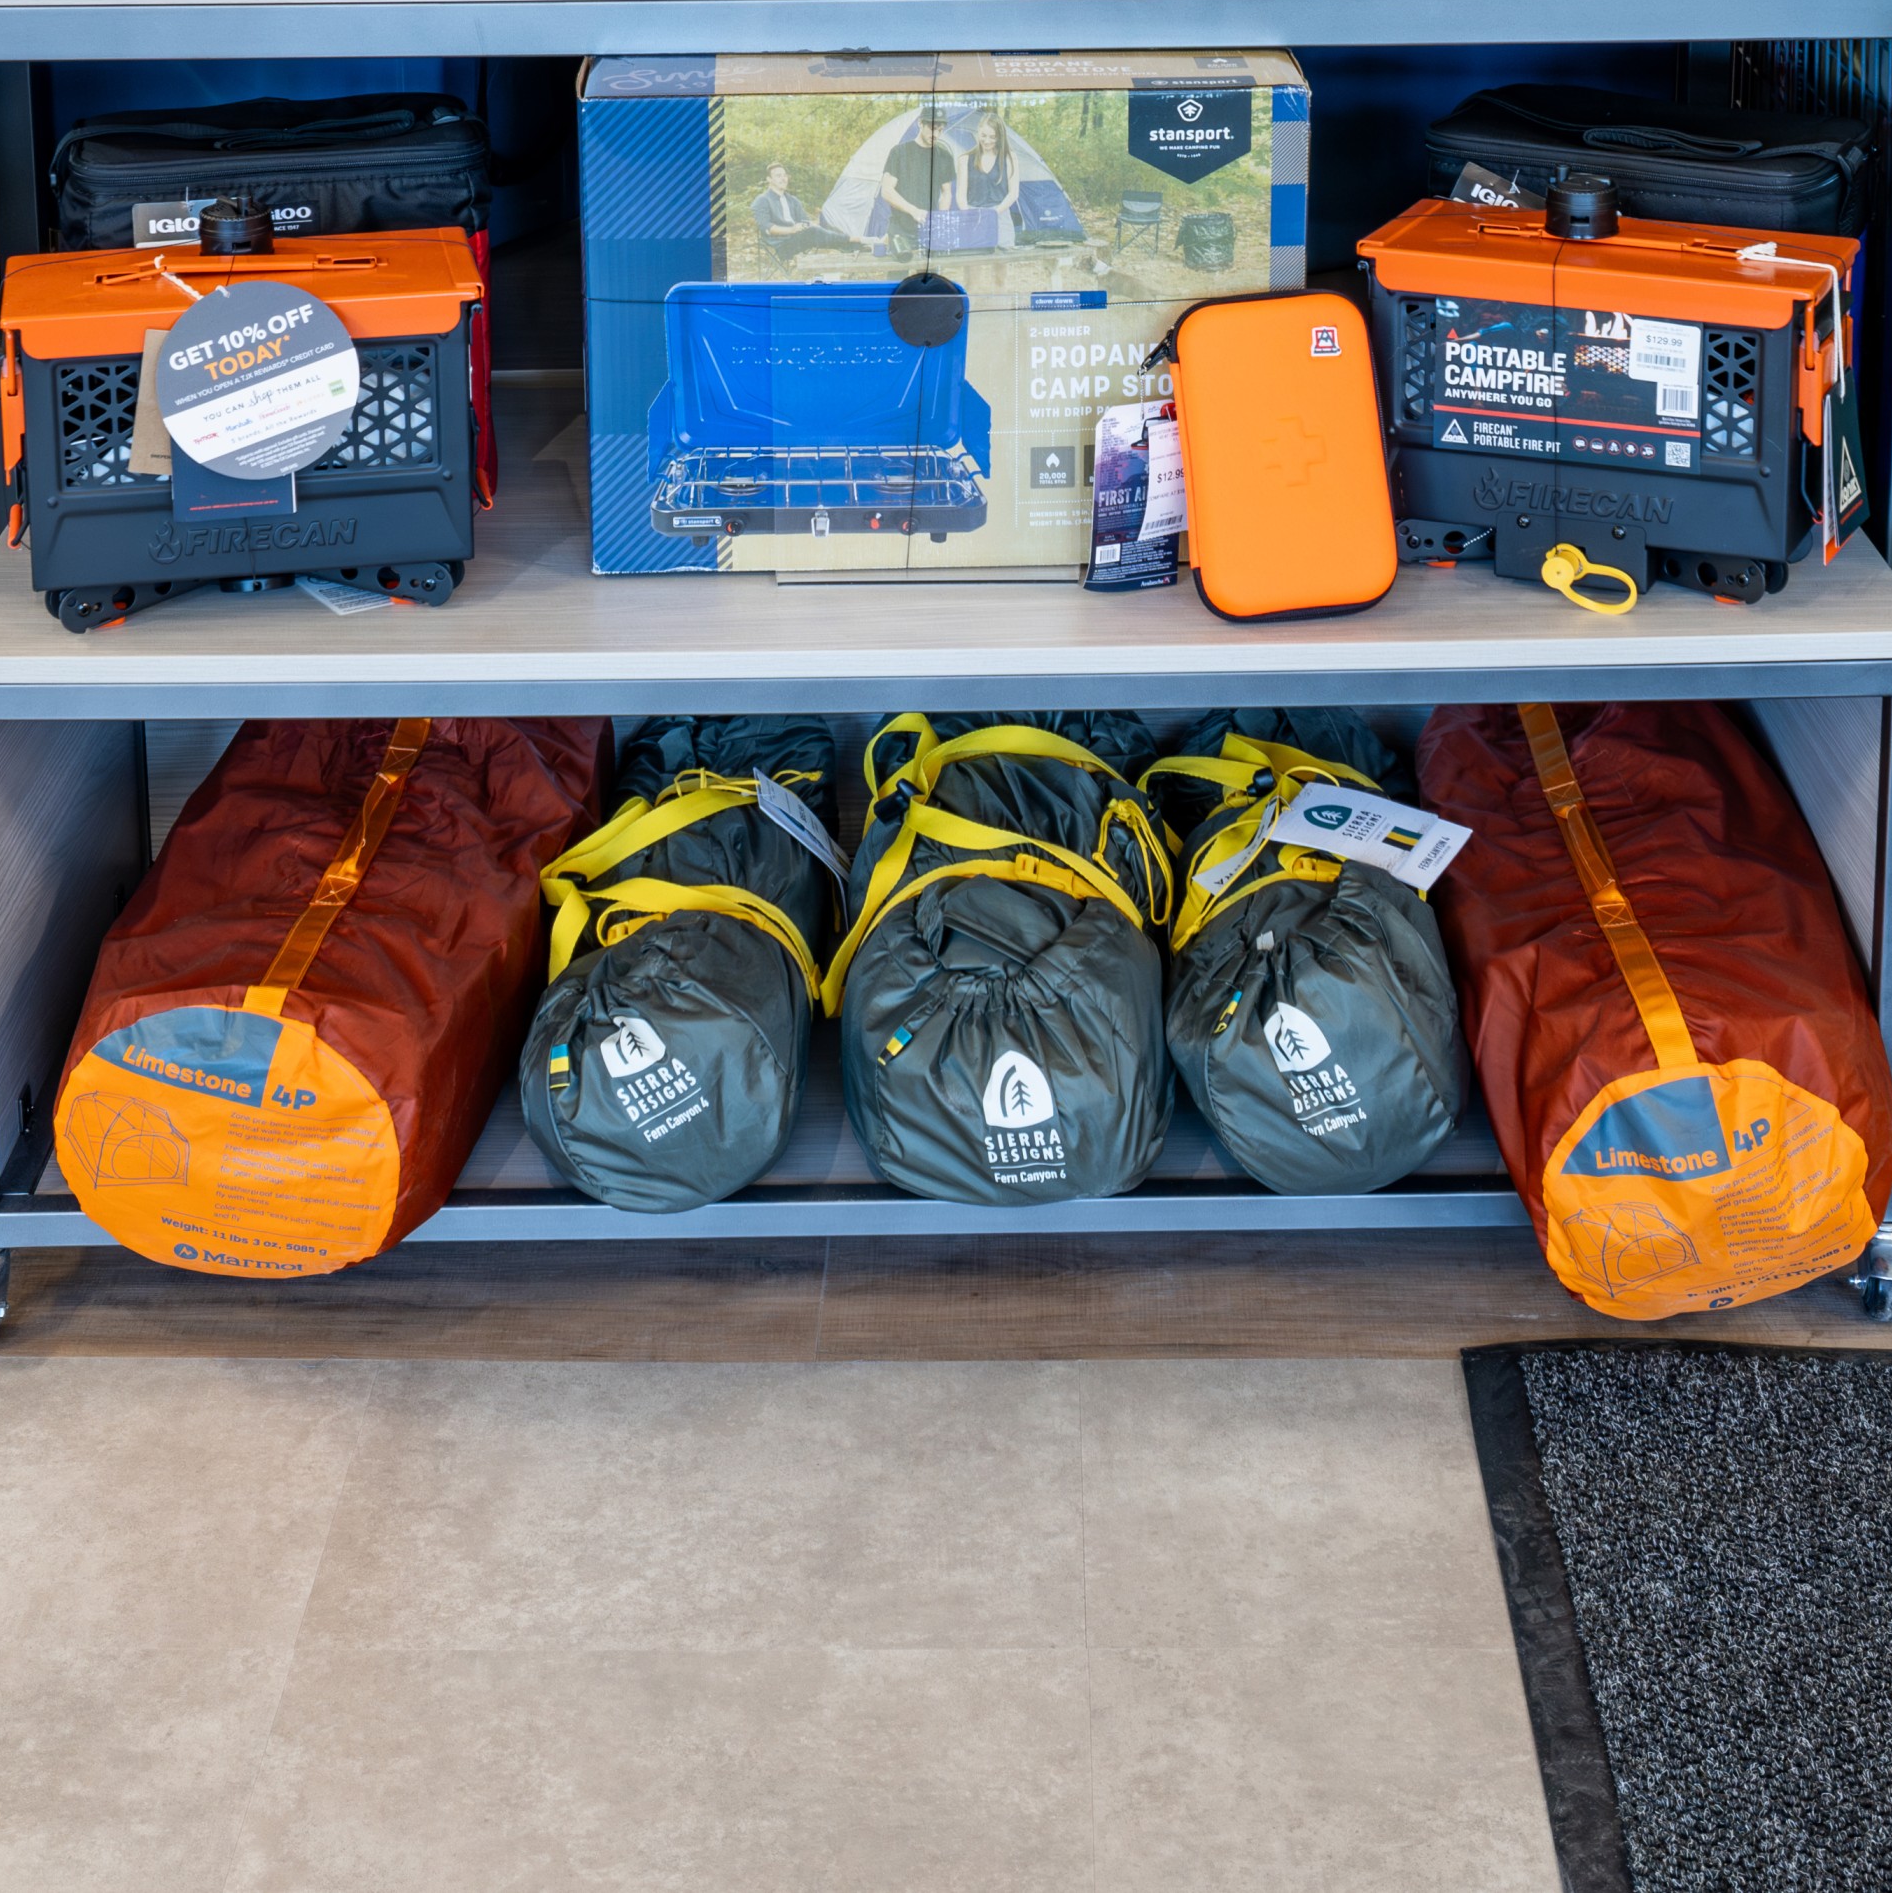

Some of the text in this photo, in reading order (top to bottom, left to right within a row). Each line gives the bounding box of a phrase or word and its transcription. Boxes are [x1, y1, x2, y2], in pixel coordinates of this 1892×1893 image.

[169, 304, 314, 370] GET 10% OFF
[1030, 325, 1091, 337] 2-BURNER
[1645, 334, 1683, 348] $129.99
[1445, 342, 1566, 373] PORTABLE
[1031, 374, 1174, 400] CAMP STO
[1445, 365, 1564, 396] CAMPFIRE
[1445, 388, 1552, 408] ANYWHERE YOU GO
[1473, 433, 1561, 453] PORTABLE FIRE PIT
[184, 518, 357, 555] FIRECAN
[122, 1044, 317, 1111] Limestone 4P
[617, 1057, 686, 1106] SIERRA
[626, 1071, 696, 1121] DESIGNS
[644, 1096, 709, 1142] Fern Canyon 4
[984, 1130, 1062, 1152] SIERRA
[987, 1145, 1065, 1164] DESIGNS
[1596, 1117, 1772, 1174] Limestone 4P
[994, 1167, 1066, 1185] Fern Canyon 6
[202, 1248, 305, 1275] Marmot
